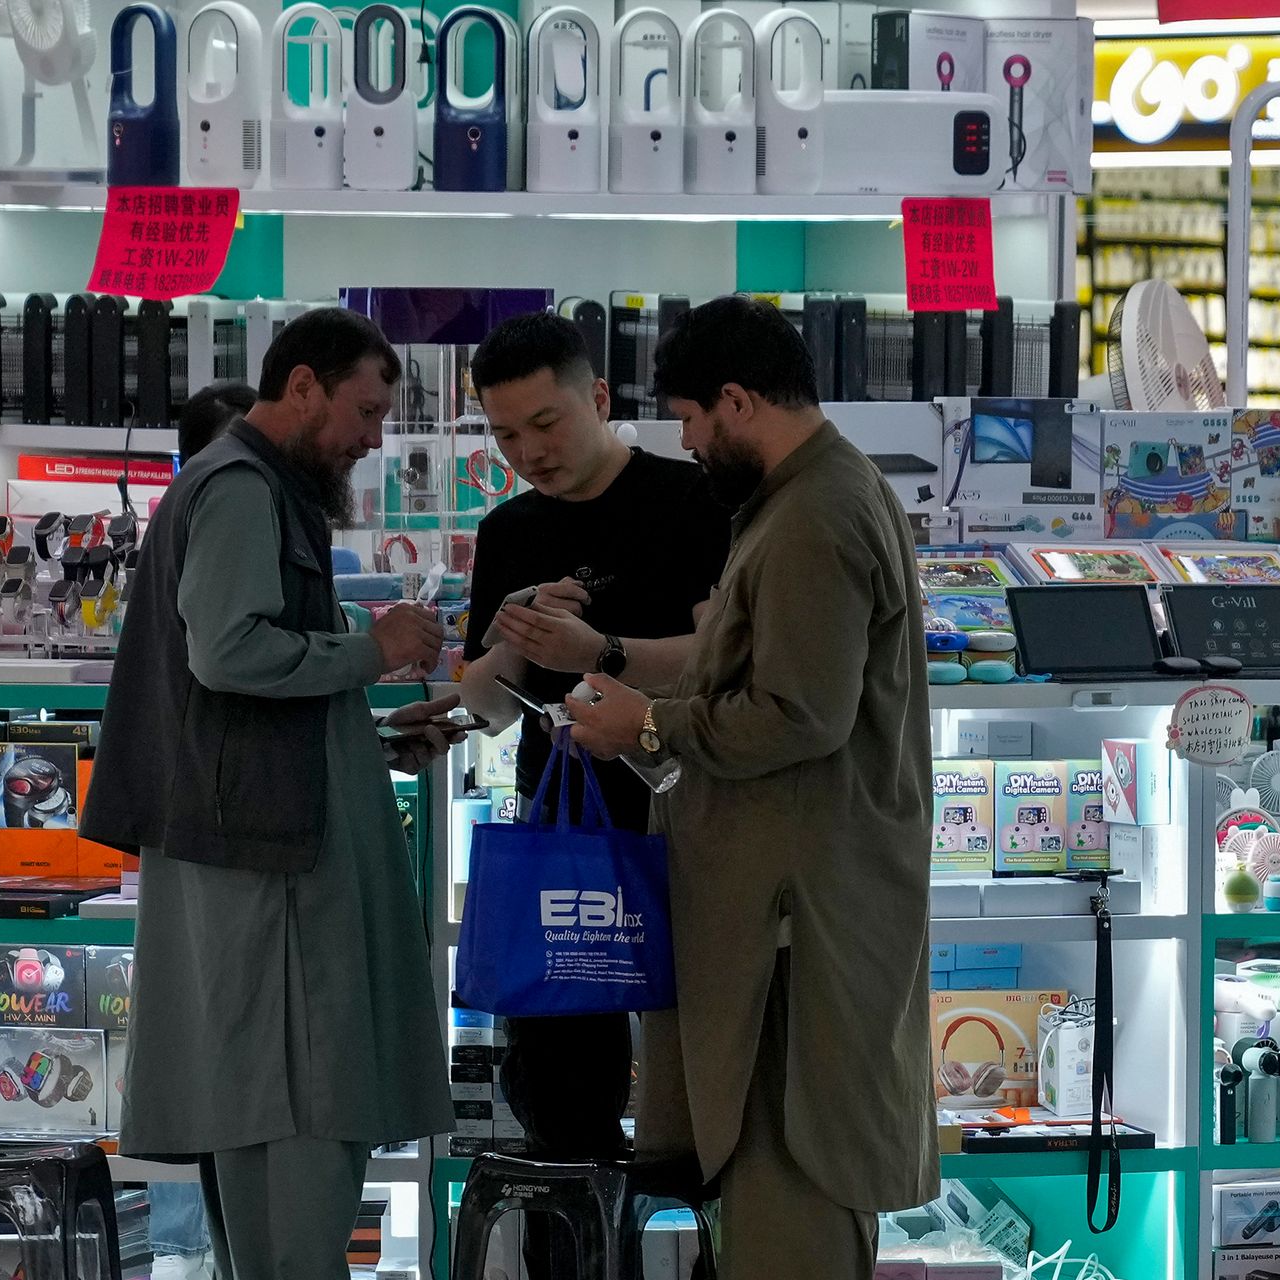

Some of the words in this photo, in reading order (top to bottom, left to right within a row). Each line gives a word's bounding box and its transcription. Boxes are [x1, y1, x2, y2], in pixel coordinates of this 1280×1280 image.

[986, 30, 1015, 38] Leafless
[1017, 30, 1031, 38] hair
[1032, 31, 1053, 40] dryer
[115, 193, 229, 217] 本店招聘营业员
[909, 204, 986, 227] 本店招聘营业员
[130, 221, 210, 243] 有经验优先
[922, 231, 976, 253] 有经验优先
[121, 248, 210, 268] 工资1W-2W
[99, 269, 147, 292] 联系电话
[45, 463, 75, 475] LED
[936, 773, 957, 787] DIY
[1010, 773, 1033, 787] DIY
[1078, 772, 1099, 786] DIY
[956, 785, 986, 794] Camera
[1005, 786, 1031, 795] Digital
[1030, 786, 1060, 794] Camera
[1072, 784, 1096, 793] Digital
[544, 930, 581, 944] Quality
[582, 930, 612, 944] Lighten
[613, 931, 630, 944] the
[3, 1013, 21, 1022] HW
[24, 1014, 32, 1022] X
[34, 1014, 56, 1023] MINI
